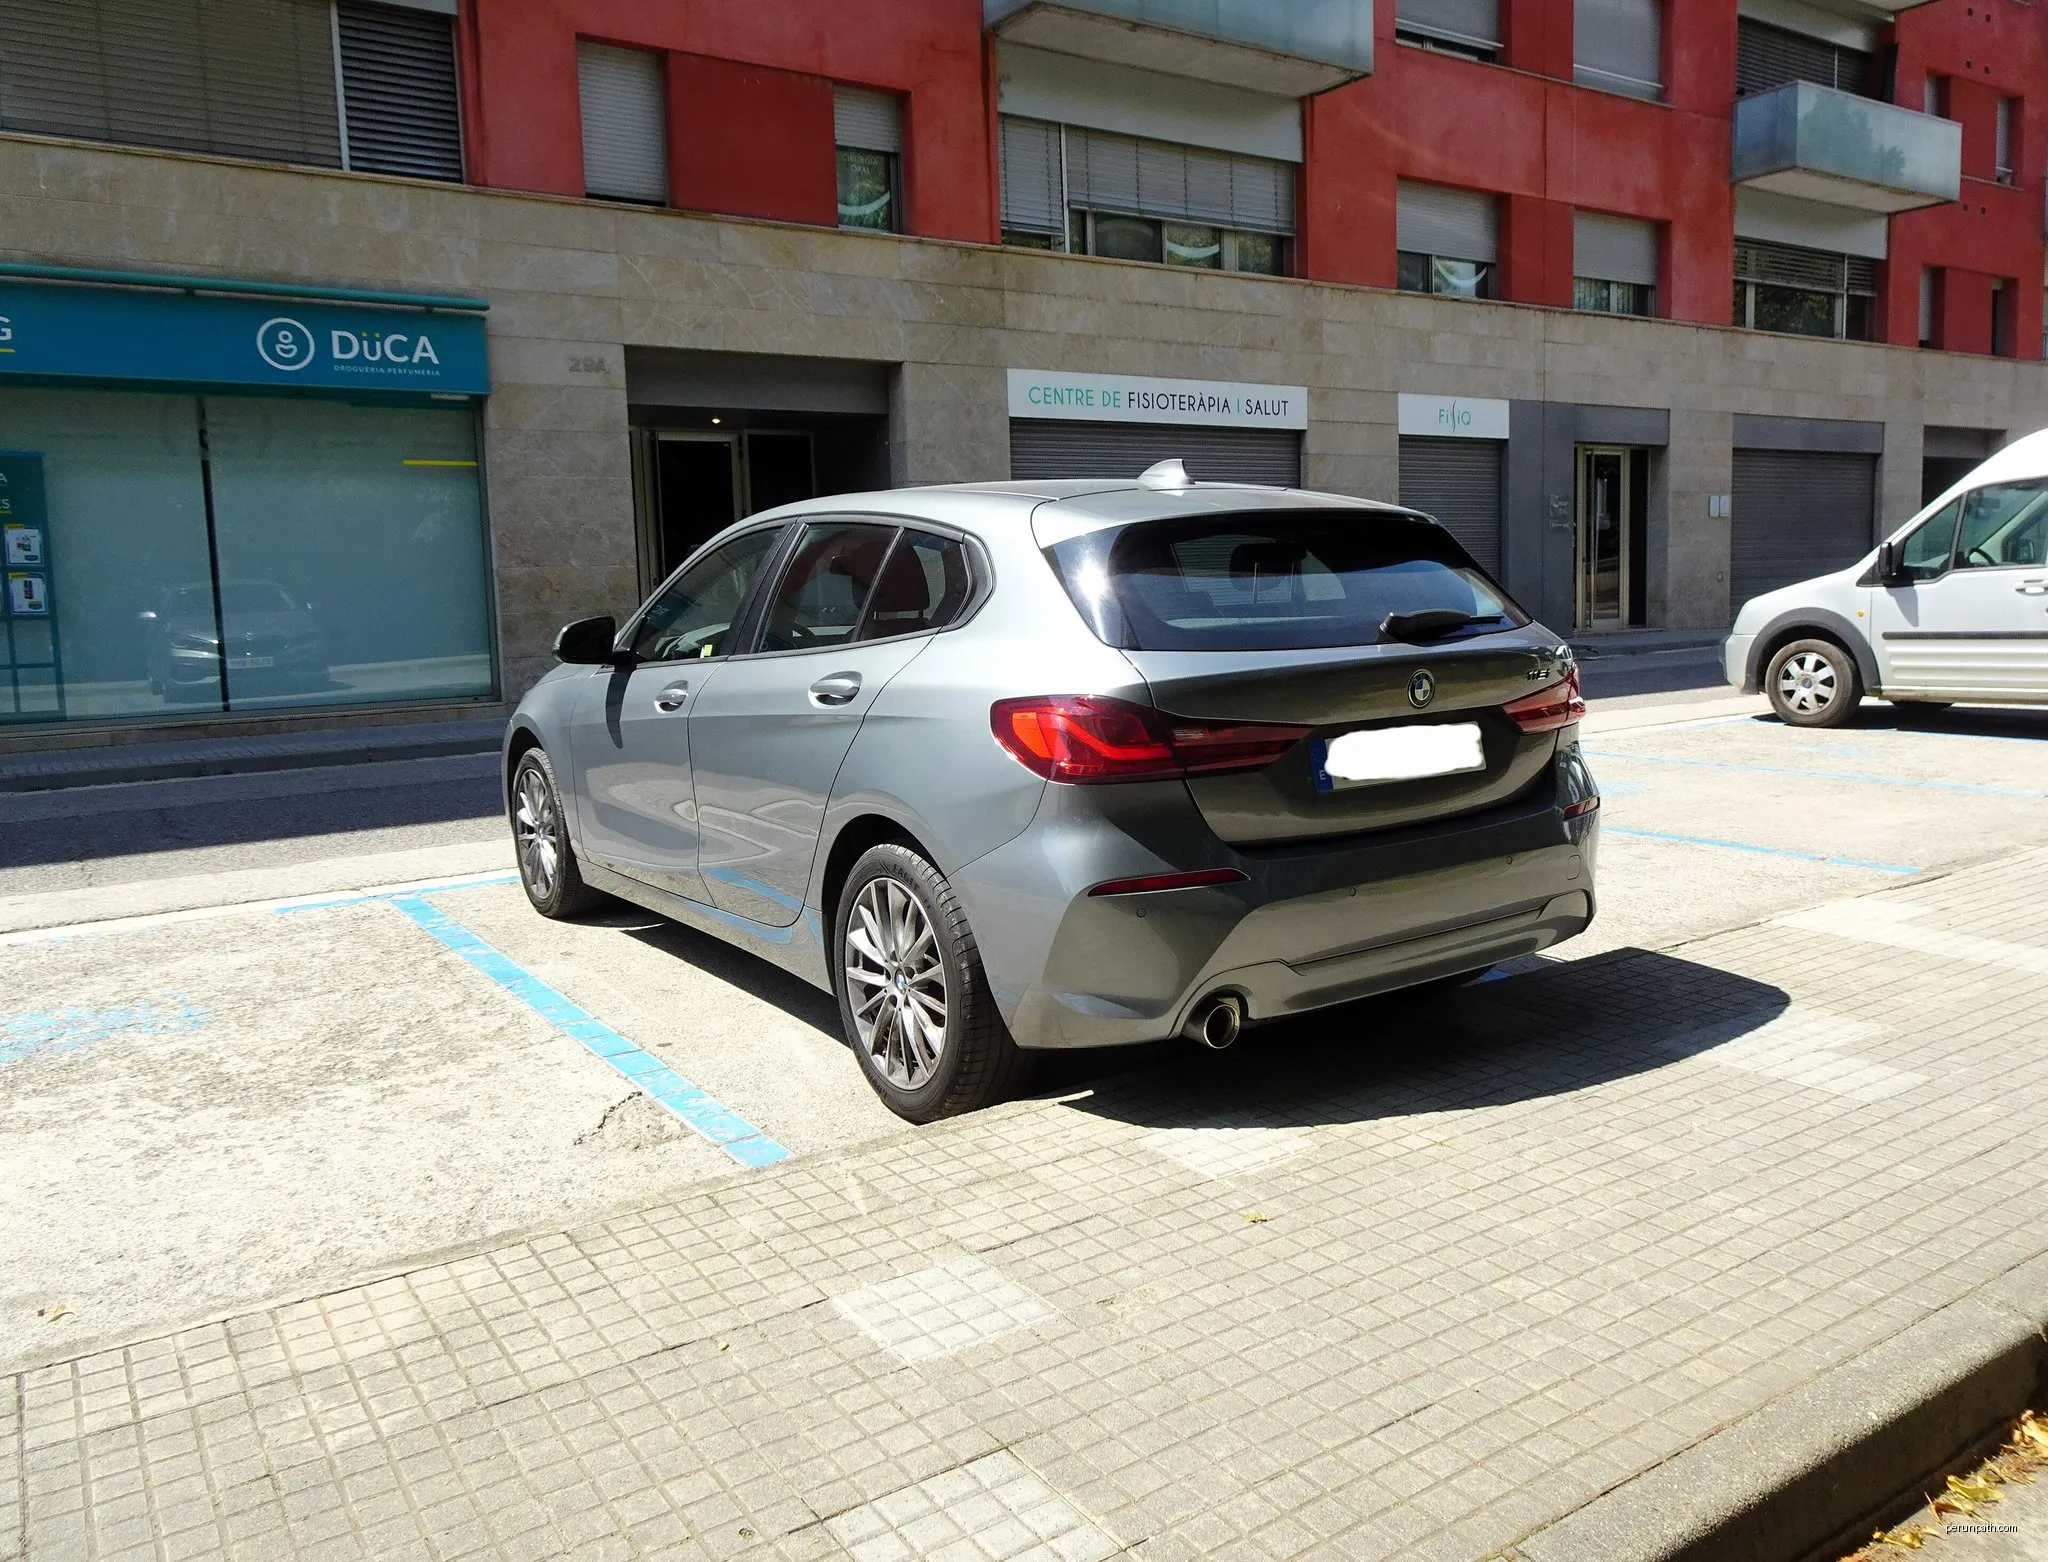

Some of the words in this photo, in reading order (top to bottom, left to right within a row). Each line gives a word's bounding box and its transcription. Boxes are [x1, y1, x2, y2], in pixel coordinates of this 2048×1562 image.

[1028, 386, 1095, 407] CENTRE
[1101, 389, 1121, 409] DE
[1128, 390, 1231, 414] FISIOTERÀPIA
[1245, 398, 1288, 416] SALUT
[1319, 769, 1327, 781] E
